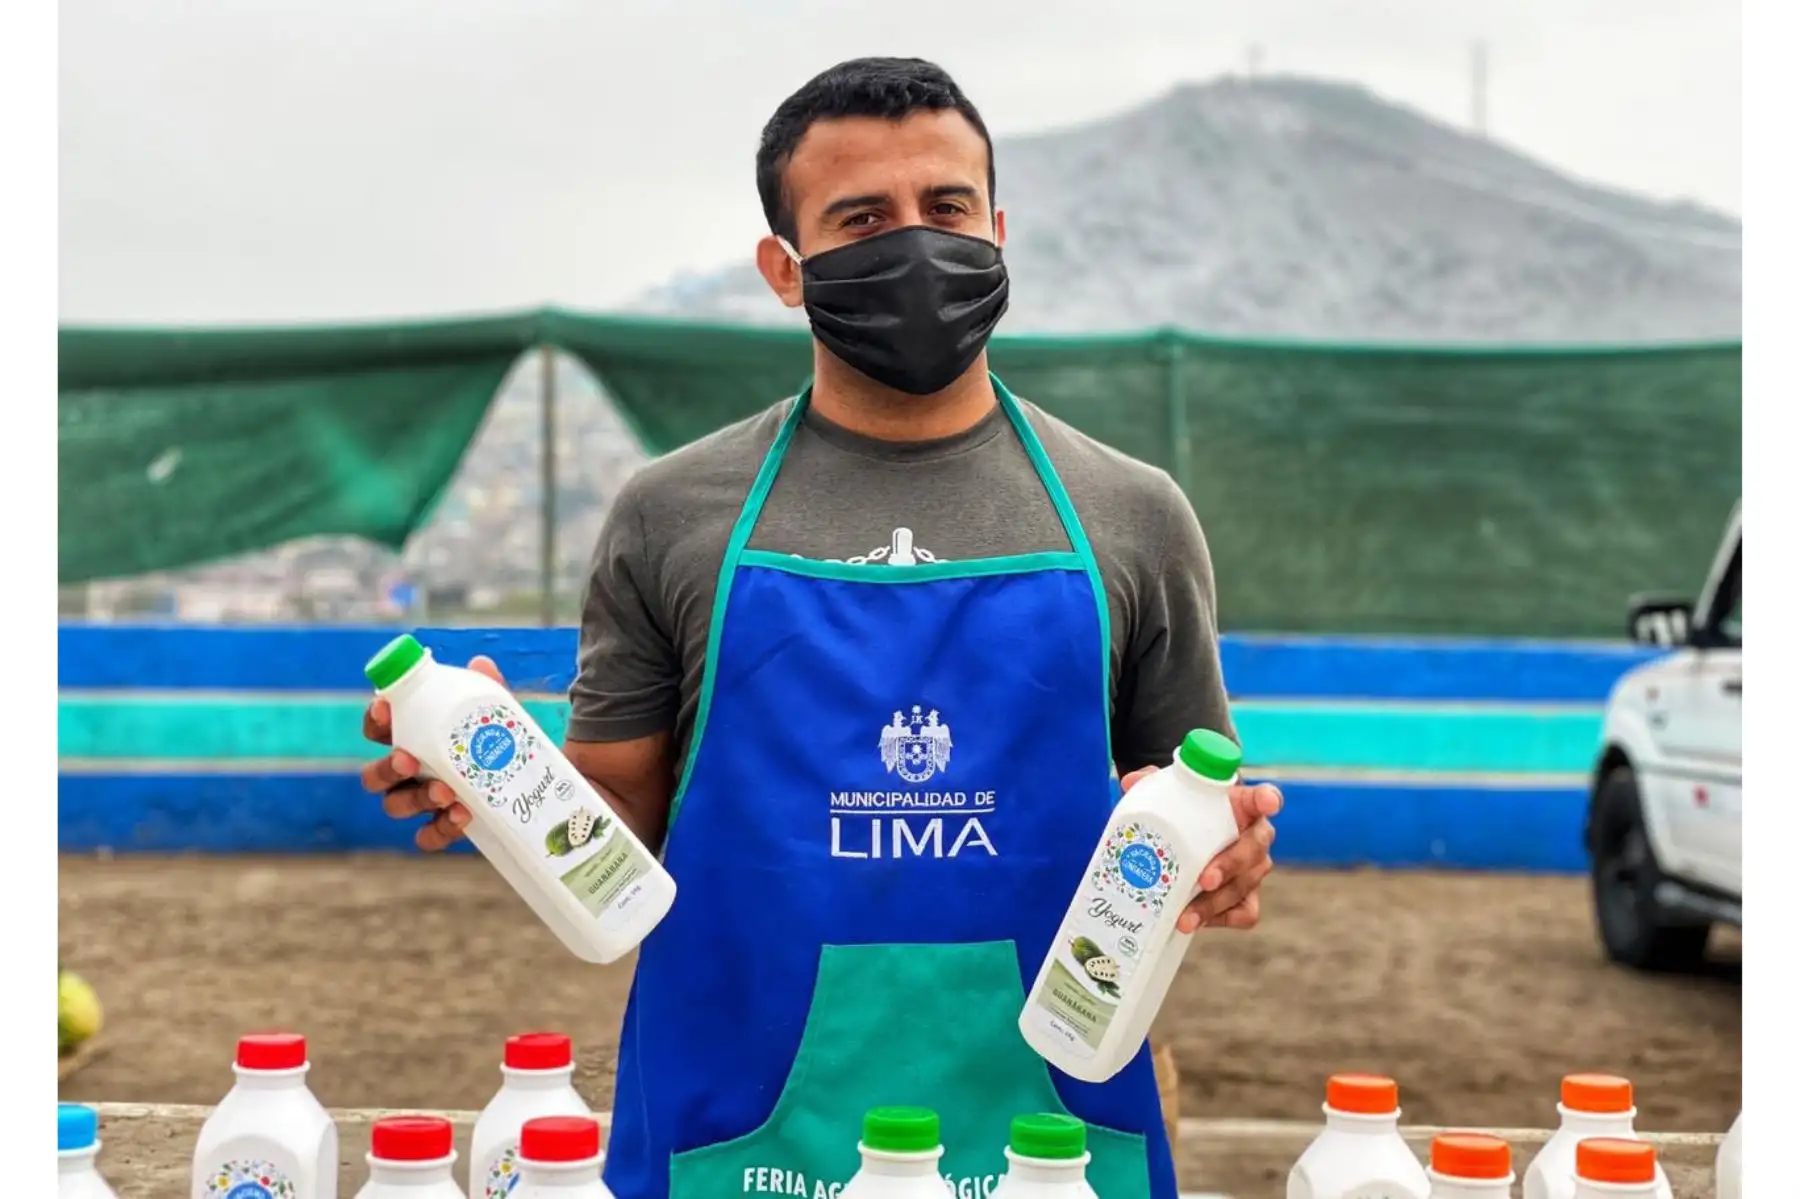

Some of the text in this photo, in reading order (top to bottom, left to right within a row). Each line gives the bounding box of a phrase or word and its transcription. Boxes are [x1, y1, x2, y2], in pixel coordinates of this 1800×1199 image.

[512, 766, 555, 824] Yogurt
[830, 791, 996, 807] MUNICIPALIDAD DE
[831, 817, 998, 859] LIMA
[1087, 898, 1143, 933] Yogurt
[743, 1166, 807, 1198] FERIA
